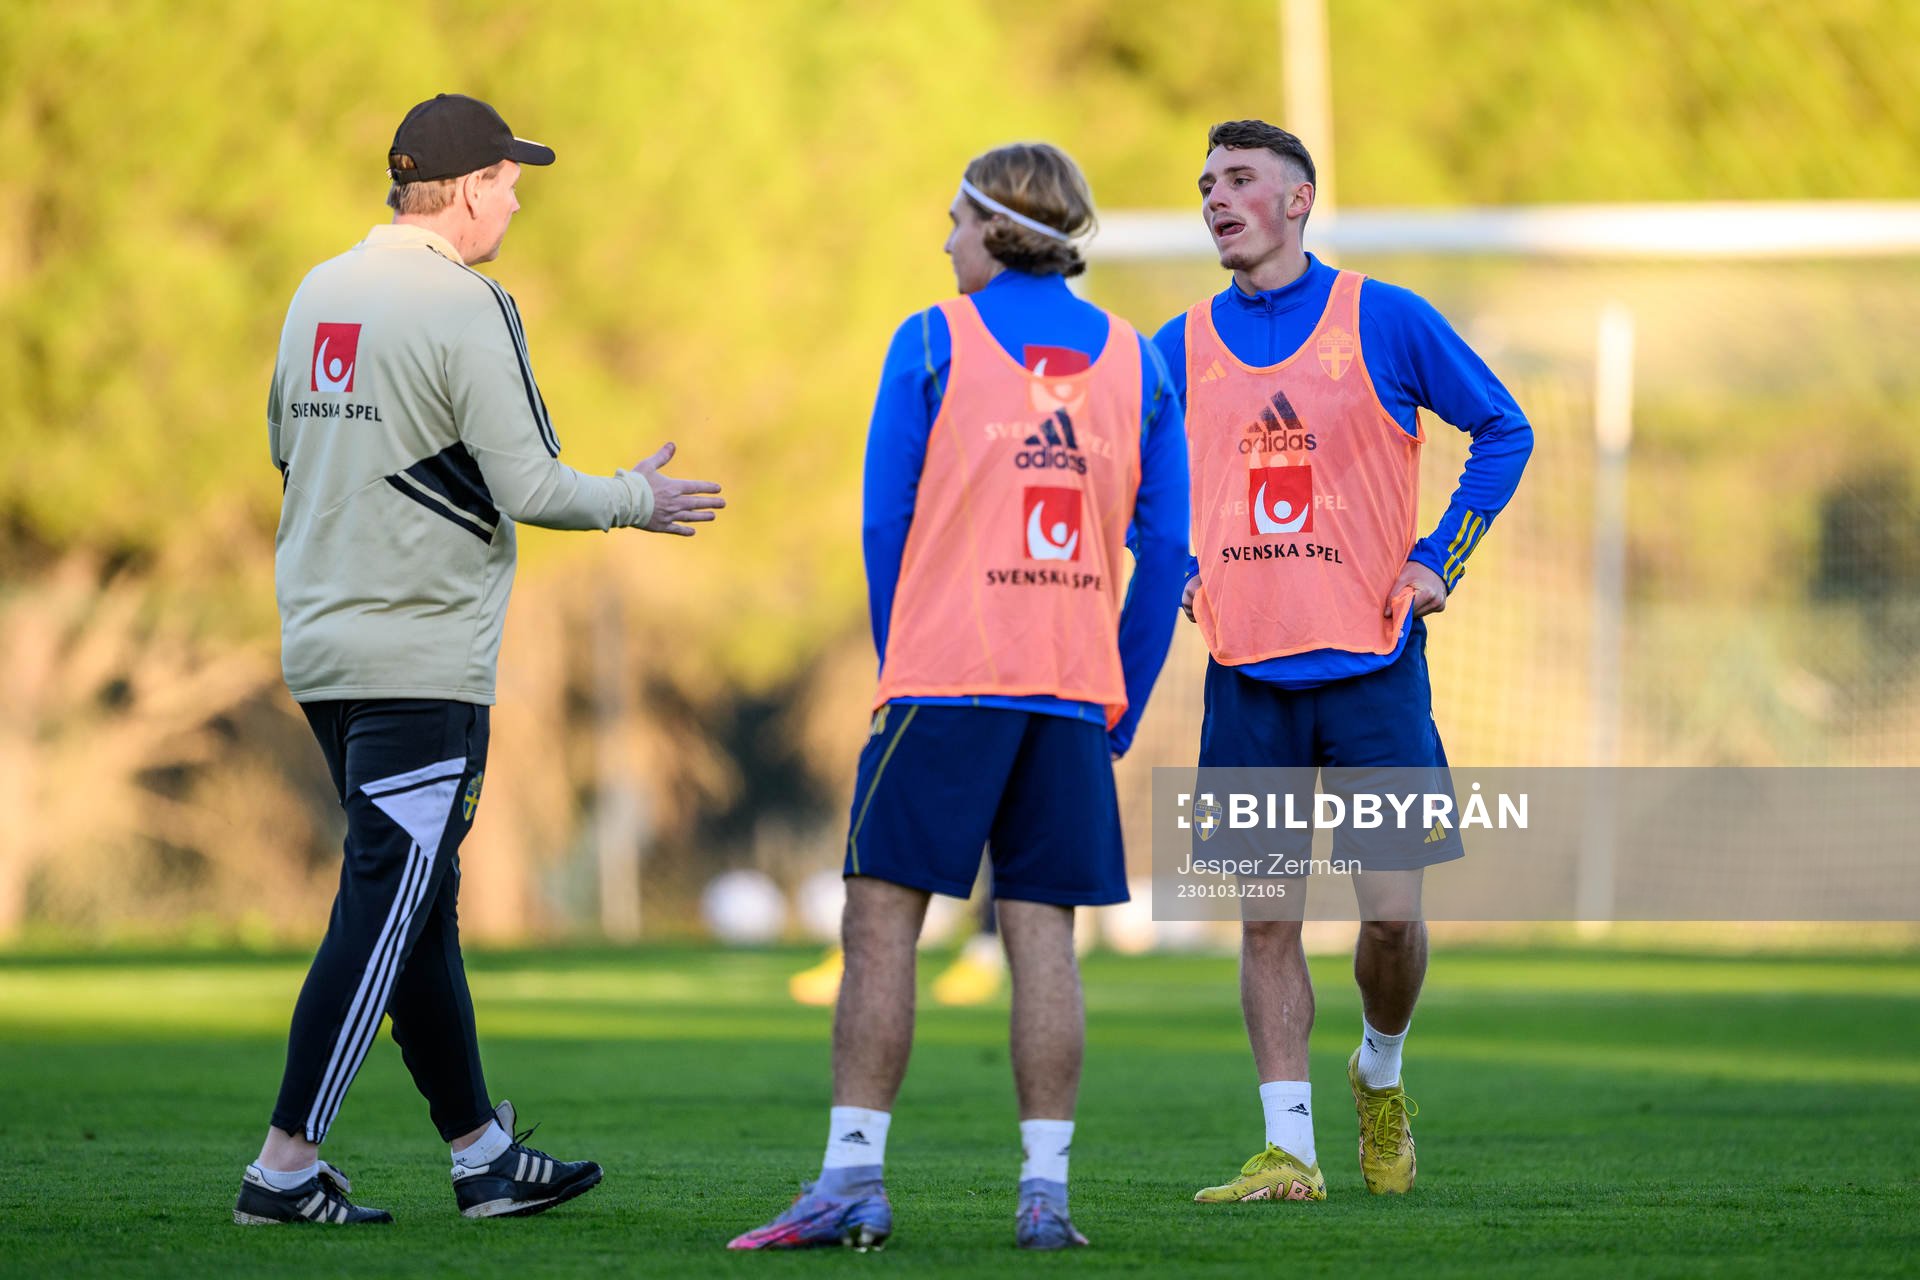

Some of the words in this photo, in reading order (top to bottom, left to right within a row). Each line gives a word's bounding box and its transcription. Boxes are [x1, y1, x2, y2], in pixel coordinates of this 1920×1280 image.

[291, 402, 340, 419] SVENSKA
[345, 403, 383, 422] SPEL
[1238, 430, 1317, 456] adidas
[1314, 494, 1348, 511] PEL
[1222, 543, 1300, 563] SVENSKA
[1305, 543, 1343, 564] SPEL
